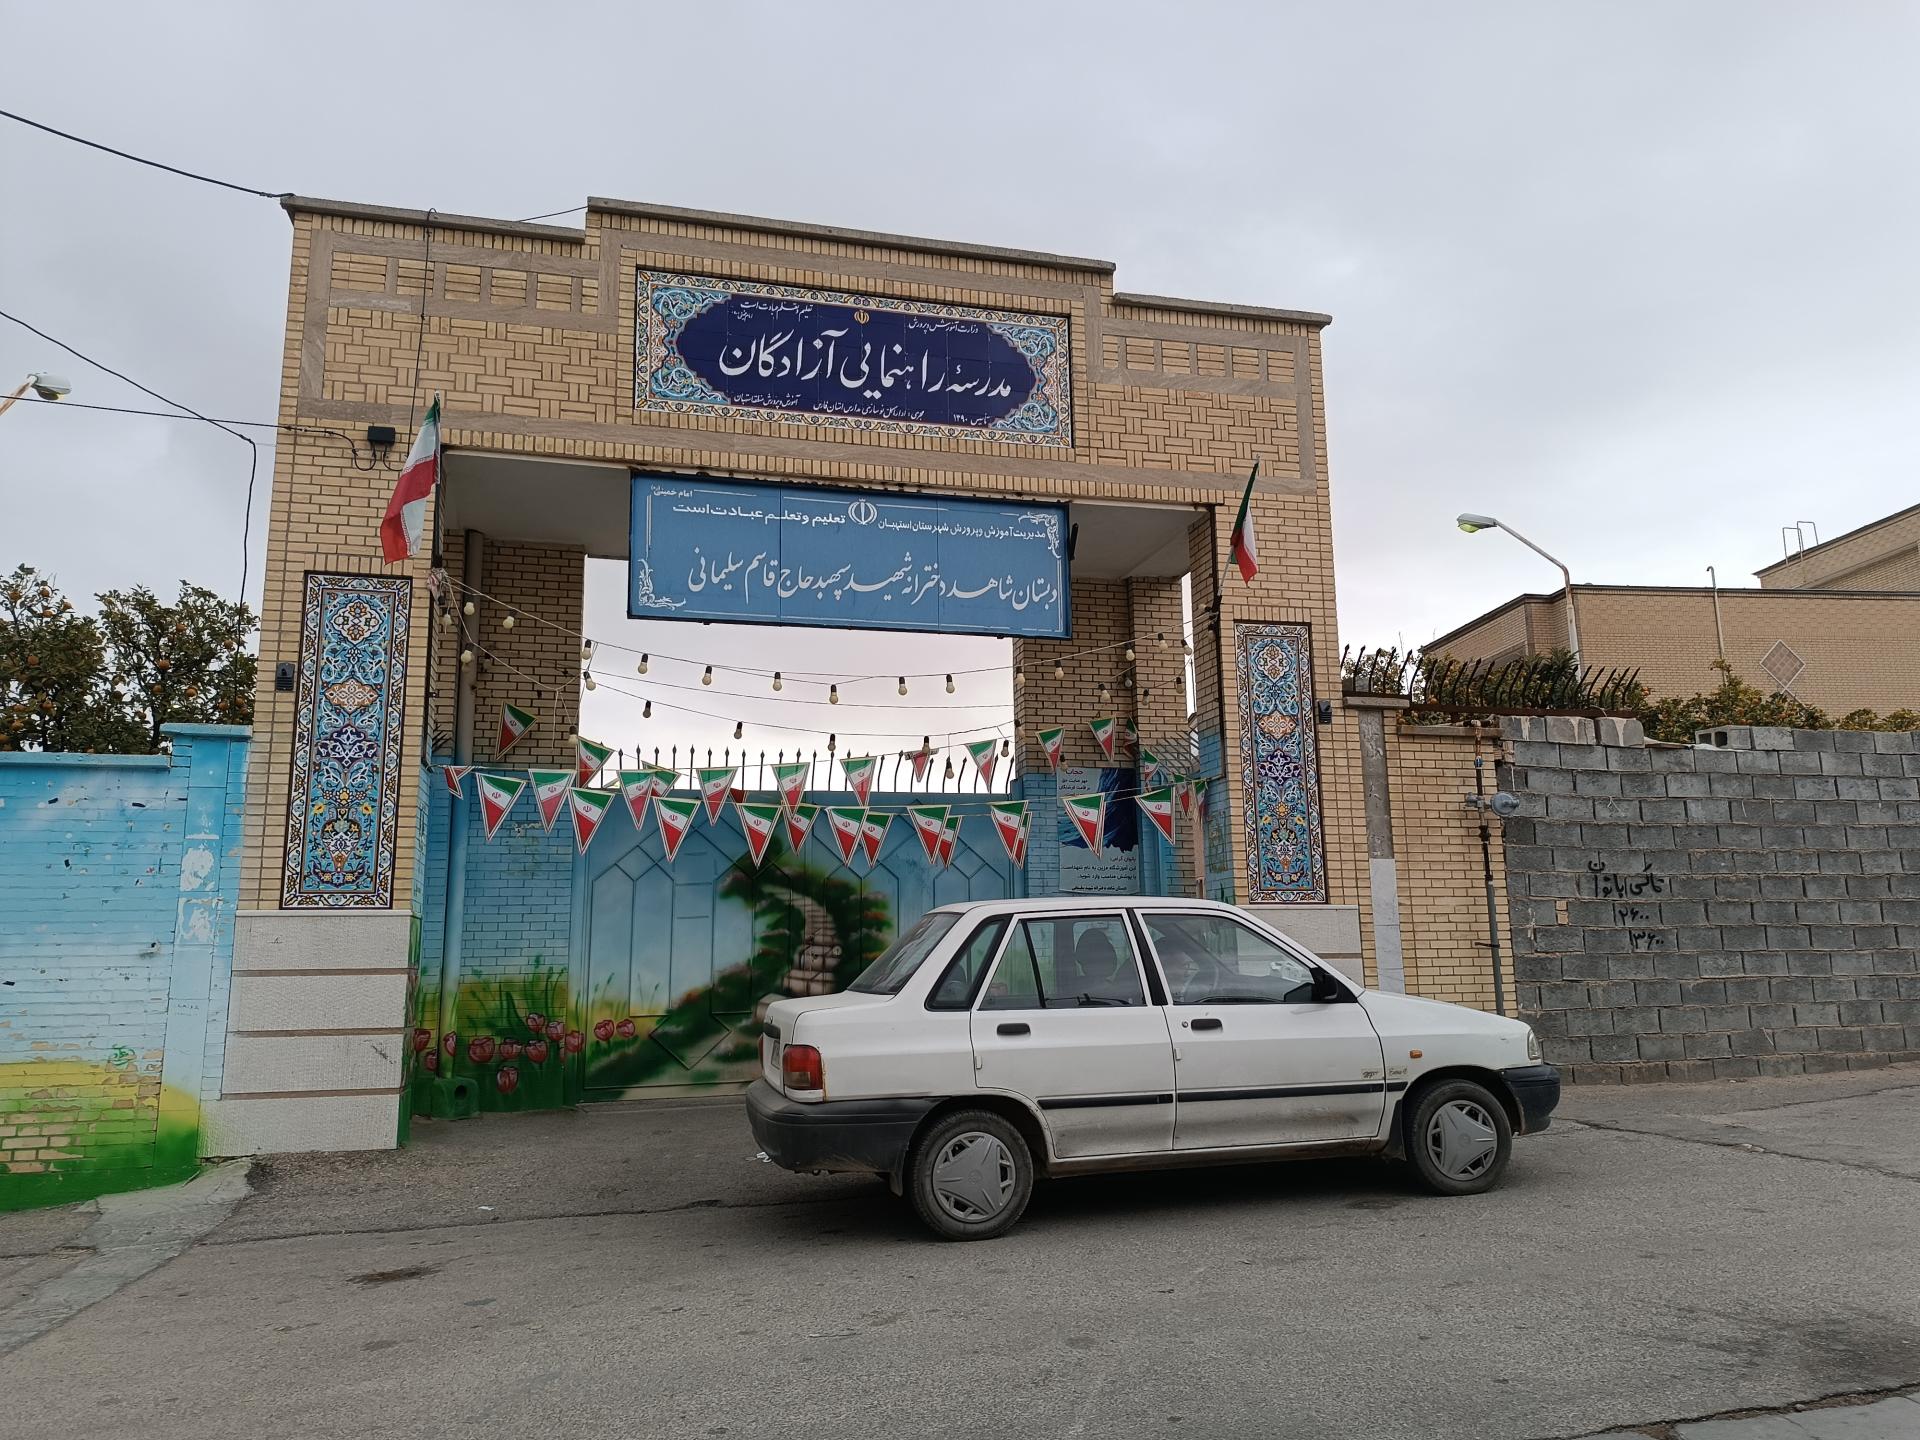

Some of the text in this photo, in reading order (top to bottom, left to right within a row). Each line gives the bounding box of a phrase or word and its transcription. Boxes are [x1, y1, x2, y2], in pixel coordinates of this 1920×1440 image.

[929, 318, 959, 332] آموزش
[958, 324, 979, 334] وزارت
[719, 328, 849, 381] آزادگان
[839, 341, 946, 400] راهنمایی
[782, 393, 802, 407] آموزش
[653, 488, 677, 497] خمینی
[678, 490, 693, 498] امام
[672, 503, 711, 514] است
[711, 505, 764, 519] عبادت
[812, 513, 846, 527] تعلیم
[877, 518, 912, 531] استهبان
[912, 520, 949, 533] شهرستان
[984, 526, 1014, 538] آموزش
[1012, 527, 1046, 540] مدیریت
[688, 546, 1058, 611] دبستان شاهد دخترانه شهید سپهبد حاج قاسم سلیمانی
